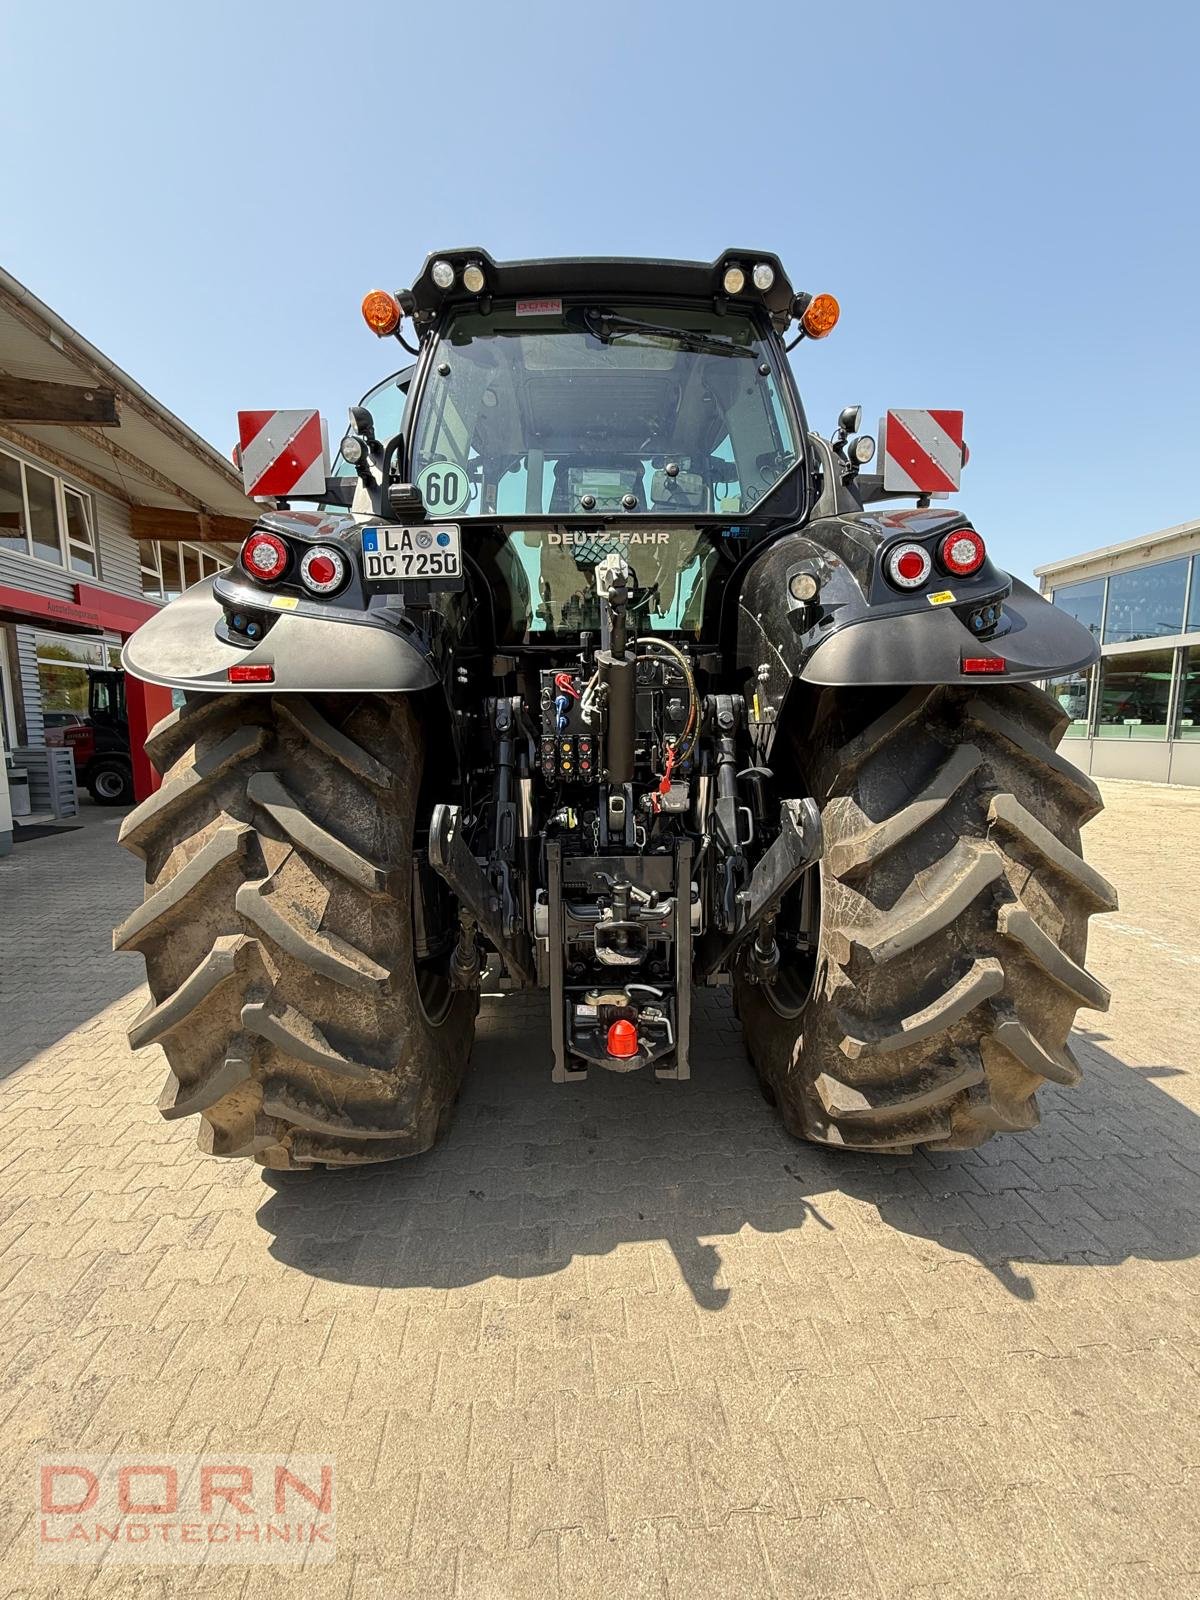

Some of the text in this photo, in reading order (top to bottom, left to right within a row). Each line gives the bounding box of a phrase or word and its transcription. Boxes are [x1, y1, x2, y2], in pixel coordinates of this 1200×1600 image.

[426, 472, 458, 506] 60
[384, 529, 413, 551] LA
[547, 532, 670, 545] DEUTZ-FAHR
[368, 553, 457, 577] DC 7250
